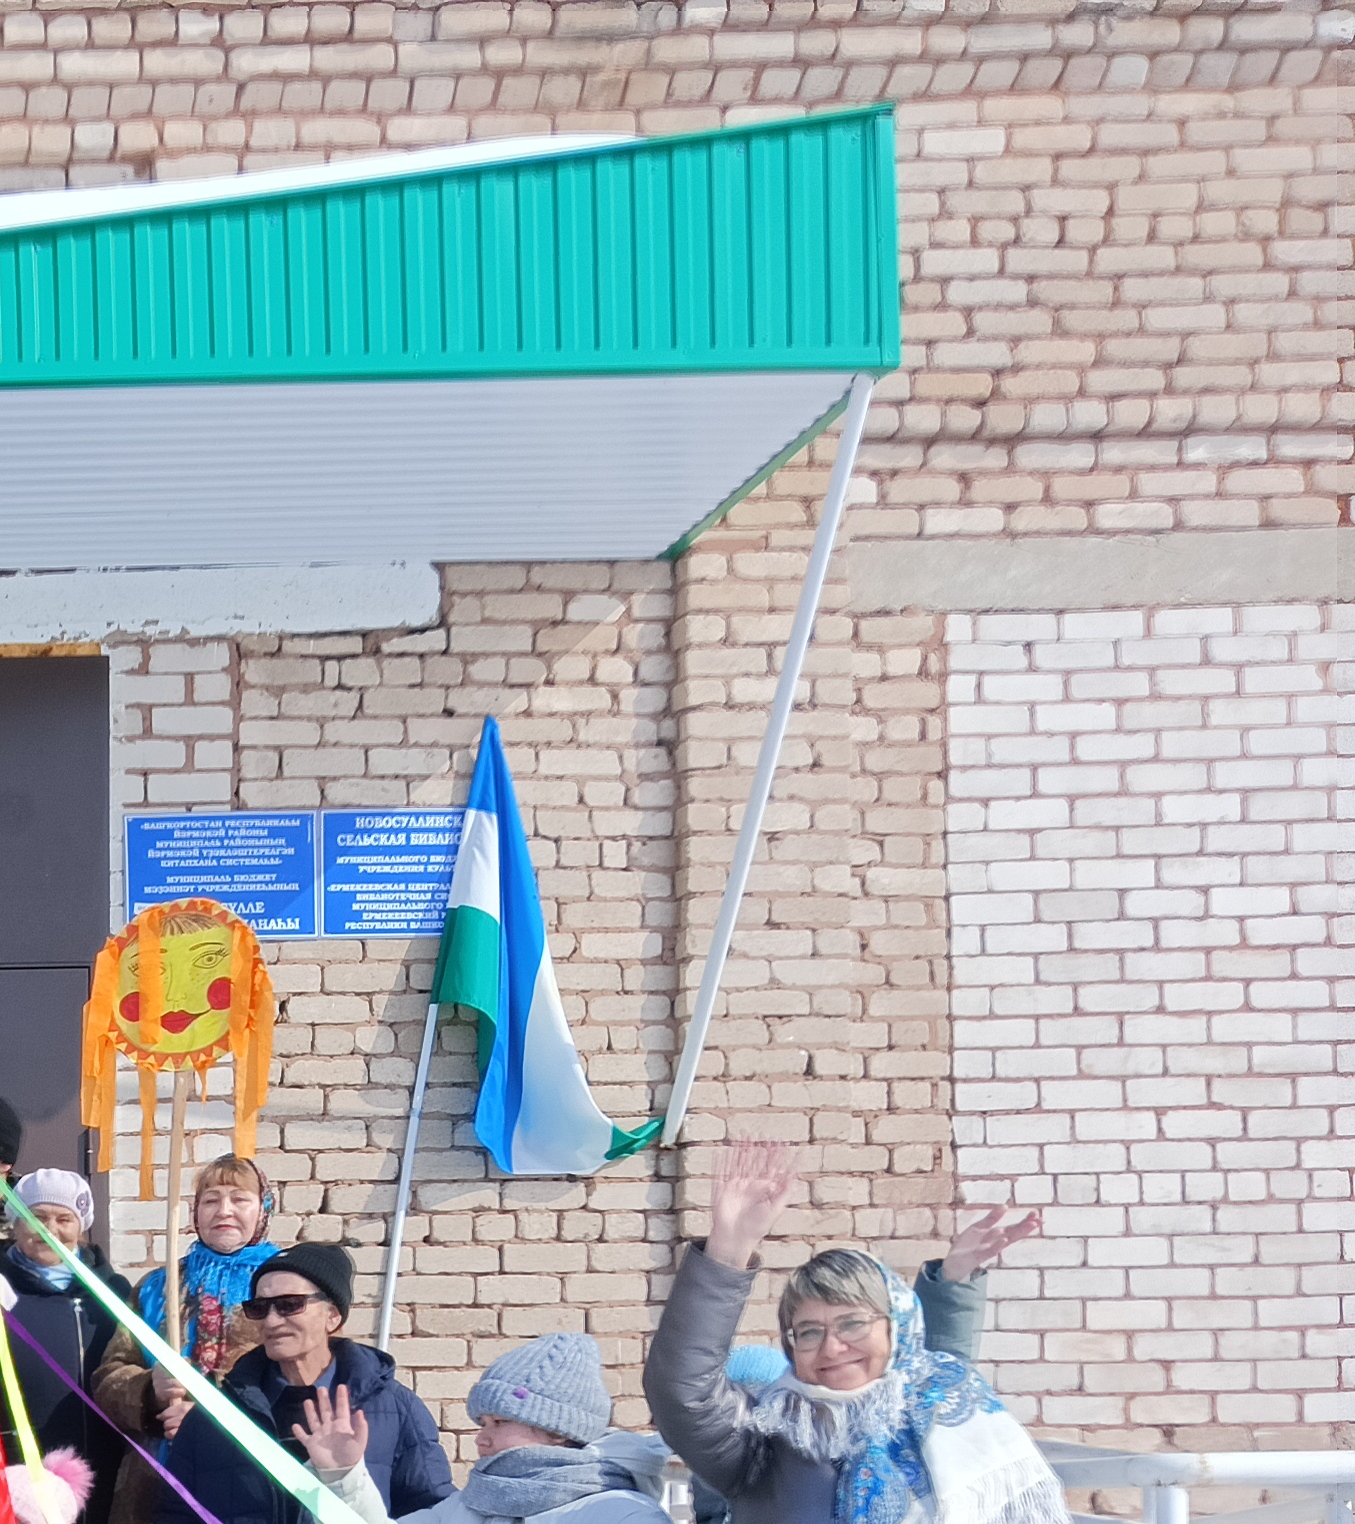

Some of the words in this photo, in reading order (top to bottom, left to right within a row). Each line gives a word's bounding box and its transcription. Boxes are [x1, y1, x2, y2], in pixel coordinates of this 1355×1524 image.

[355, 815, 463, 829] НОВОСУЛЛИНСК
[228, 828, 268, 836] РАЙОНЫ
[156, 839, 220, 848] МУНИЦИПАЛЬ
[337, 834, 406, 846] СЕЛЬСКАЯ
[410, 833, 461, 845] БИБЛИО
[336, 855, 427, 864] МУНИЦИПАЛЬНОГО
[358, 865, 424, 873] УЧРЕЖДЕНИЯ
[166, 875, 231, 884] МУНИЦИПАЛЬ
[234, 874, 277, 882] БЮДЖЕТ
[408, 883, 451, 891] ЦЕНТРАЛ
[247, 918, 299, 929] АНАҺЫ
[345, 921, 407, 929] РЕСПУБЛИКИ
